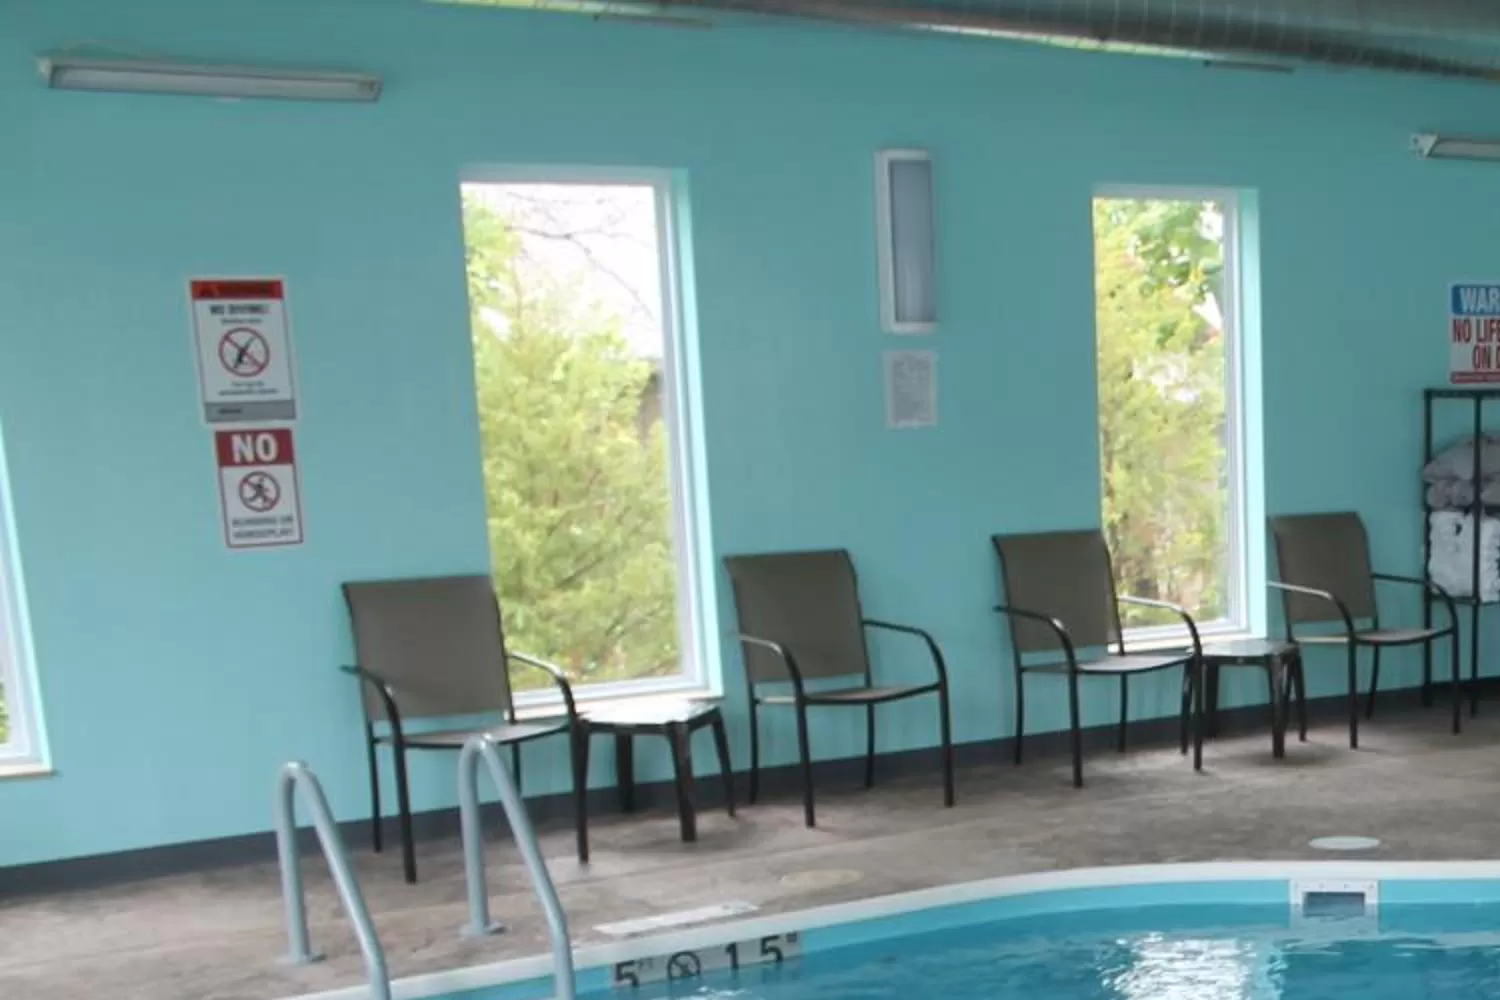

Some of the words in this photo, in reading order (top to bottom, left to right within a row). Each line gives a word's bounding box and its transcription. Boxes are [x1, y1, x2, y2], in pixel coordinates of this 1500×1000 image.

[1453, 319, 1472, 343] NO
[1472, 345, 1491, 369] ON
[231, 433, 278, 464] NO
[615, 959, 639, 988] 5
